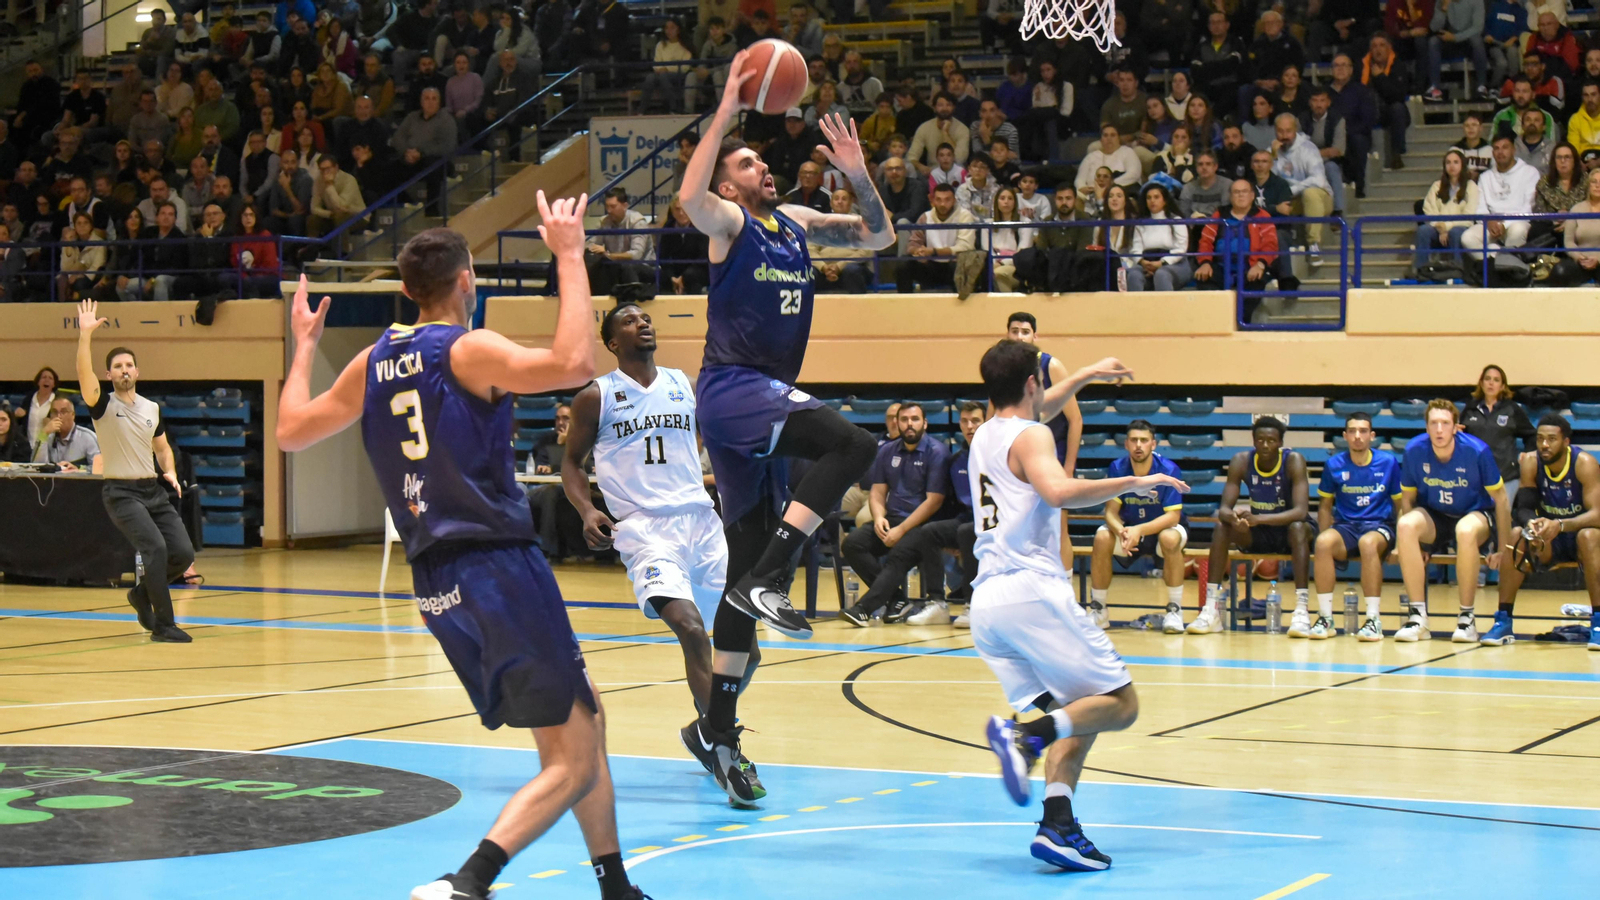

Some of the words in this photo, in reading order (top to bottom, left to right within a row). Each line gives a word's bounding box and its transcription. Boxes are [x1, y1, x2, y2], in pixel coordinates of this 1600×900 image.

[780, 289, 802, 314] 23
[390, 389, 429, 460] 3
[612, 413, 691, 439] TALAVERA
[644, 435, 667, 465] 11
[979, 472, 999, 531] 5
[1356, 495, 1370, 506] 26
[1438, 489, 1453, 505] 15
[1138, 508, 1146, 518] 9
[775, 527, 790, 539] 23
